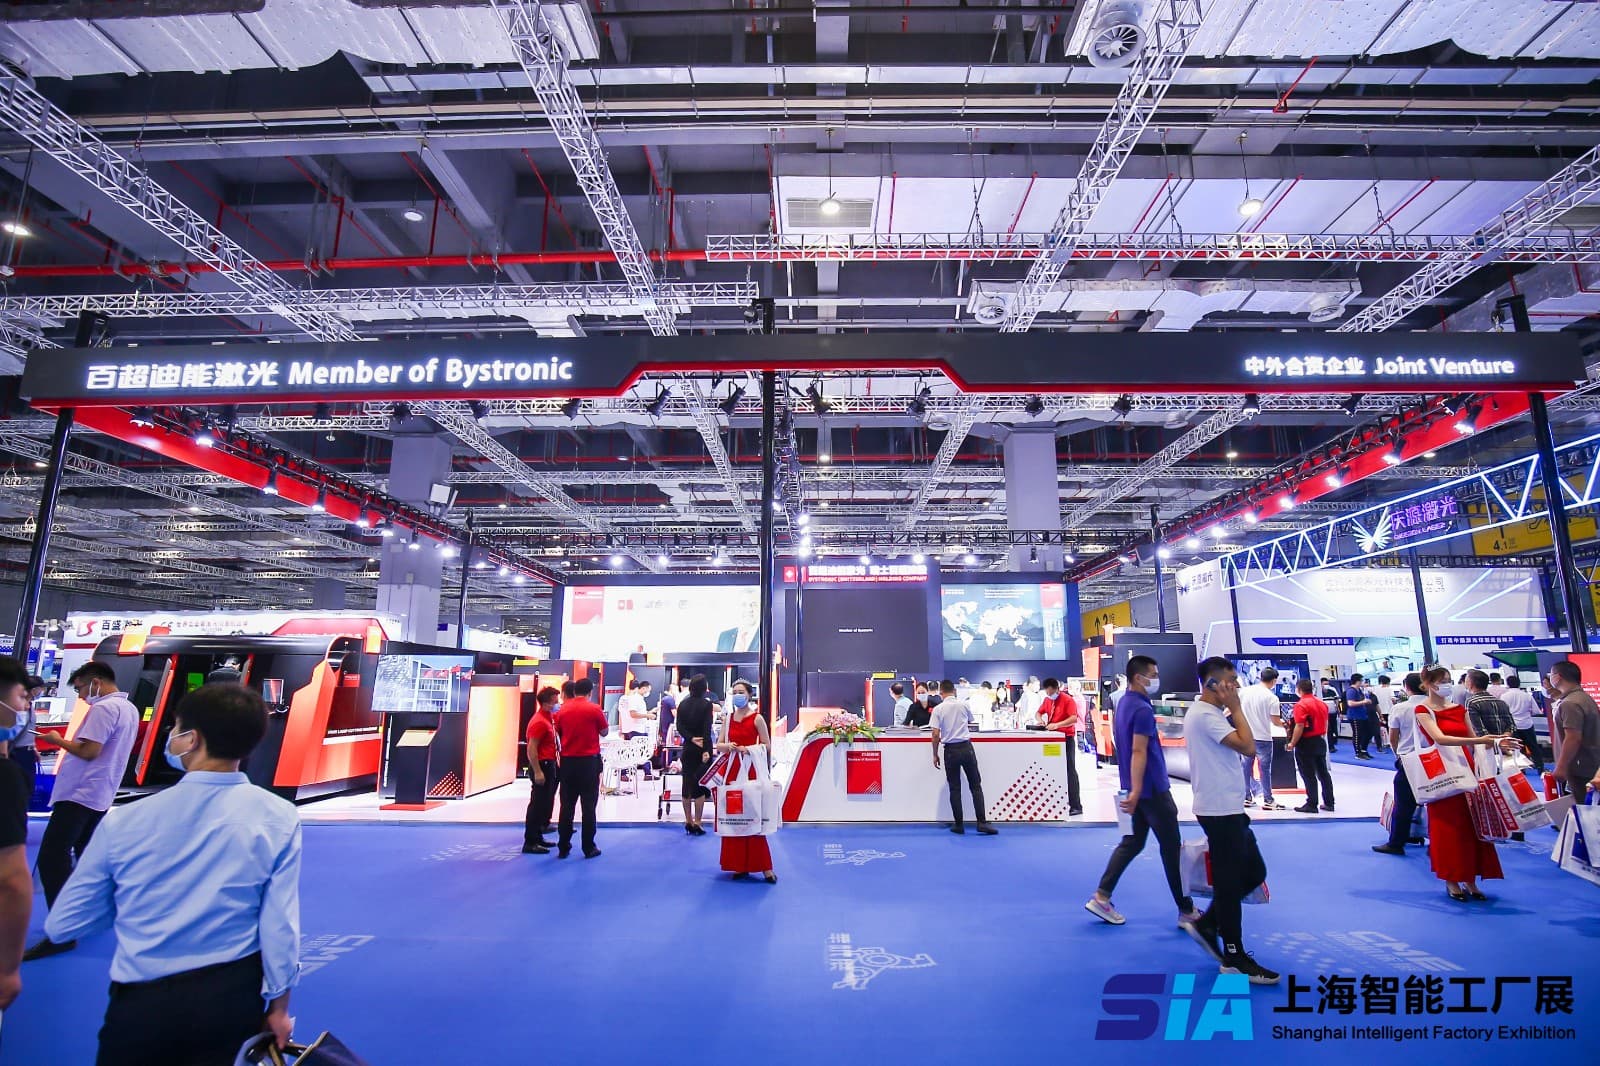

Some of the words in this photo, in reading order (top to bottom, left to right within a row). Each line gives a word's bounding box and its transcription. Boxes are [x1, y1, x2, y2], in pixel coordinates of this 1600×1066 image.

[86, 361, 279, 390] 百超迪能激光
[287, 359, 404, 385] Member
[408, 357, 440, 383] of
[445, 356, 573, 389] Bystronic
[1244, 356, 1365, 377] 中外合资企业
[1373, 356, 1427, 376] Joint
[1430, 356, 1515, 376] Venture
